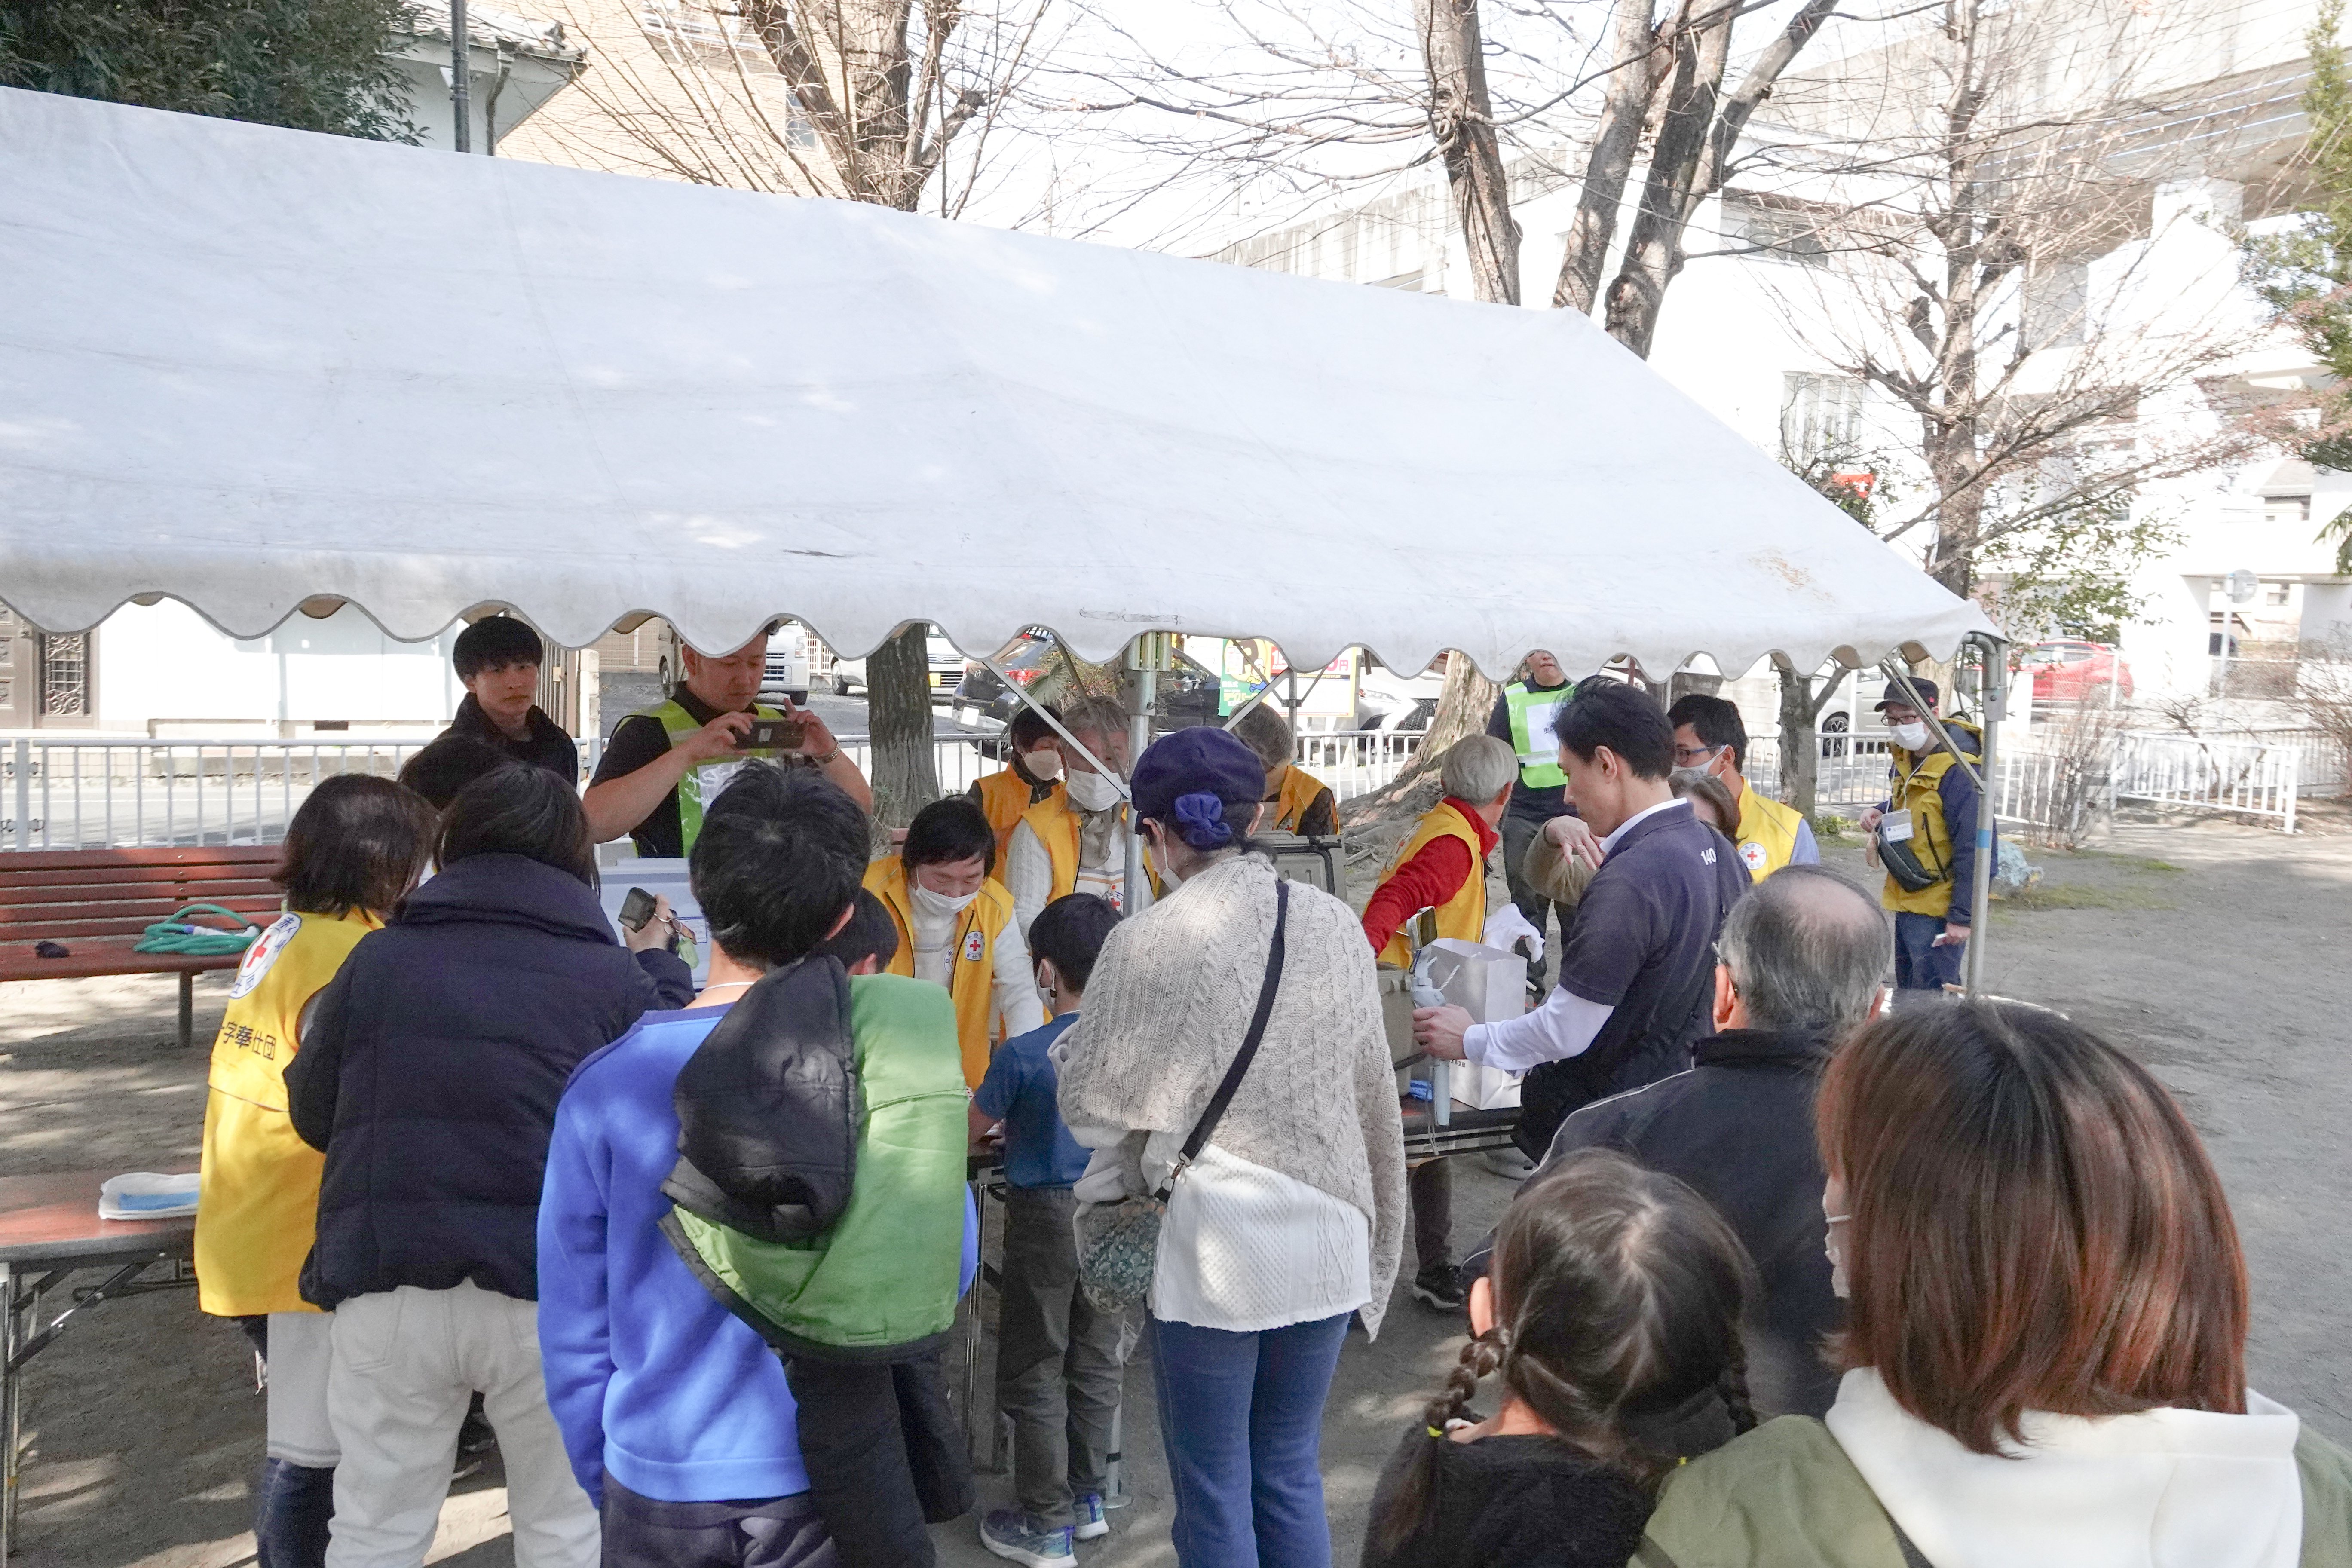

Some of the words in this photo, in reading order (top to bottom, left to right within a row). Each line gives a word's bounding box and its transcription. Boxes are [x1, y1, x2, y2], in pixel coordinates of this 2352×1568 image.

[1700, 848, 1717, 865] 140
[220, 1021, 276, 1061] 字奉仕団
